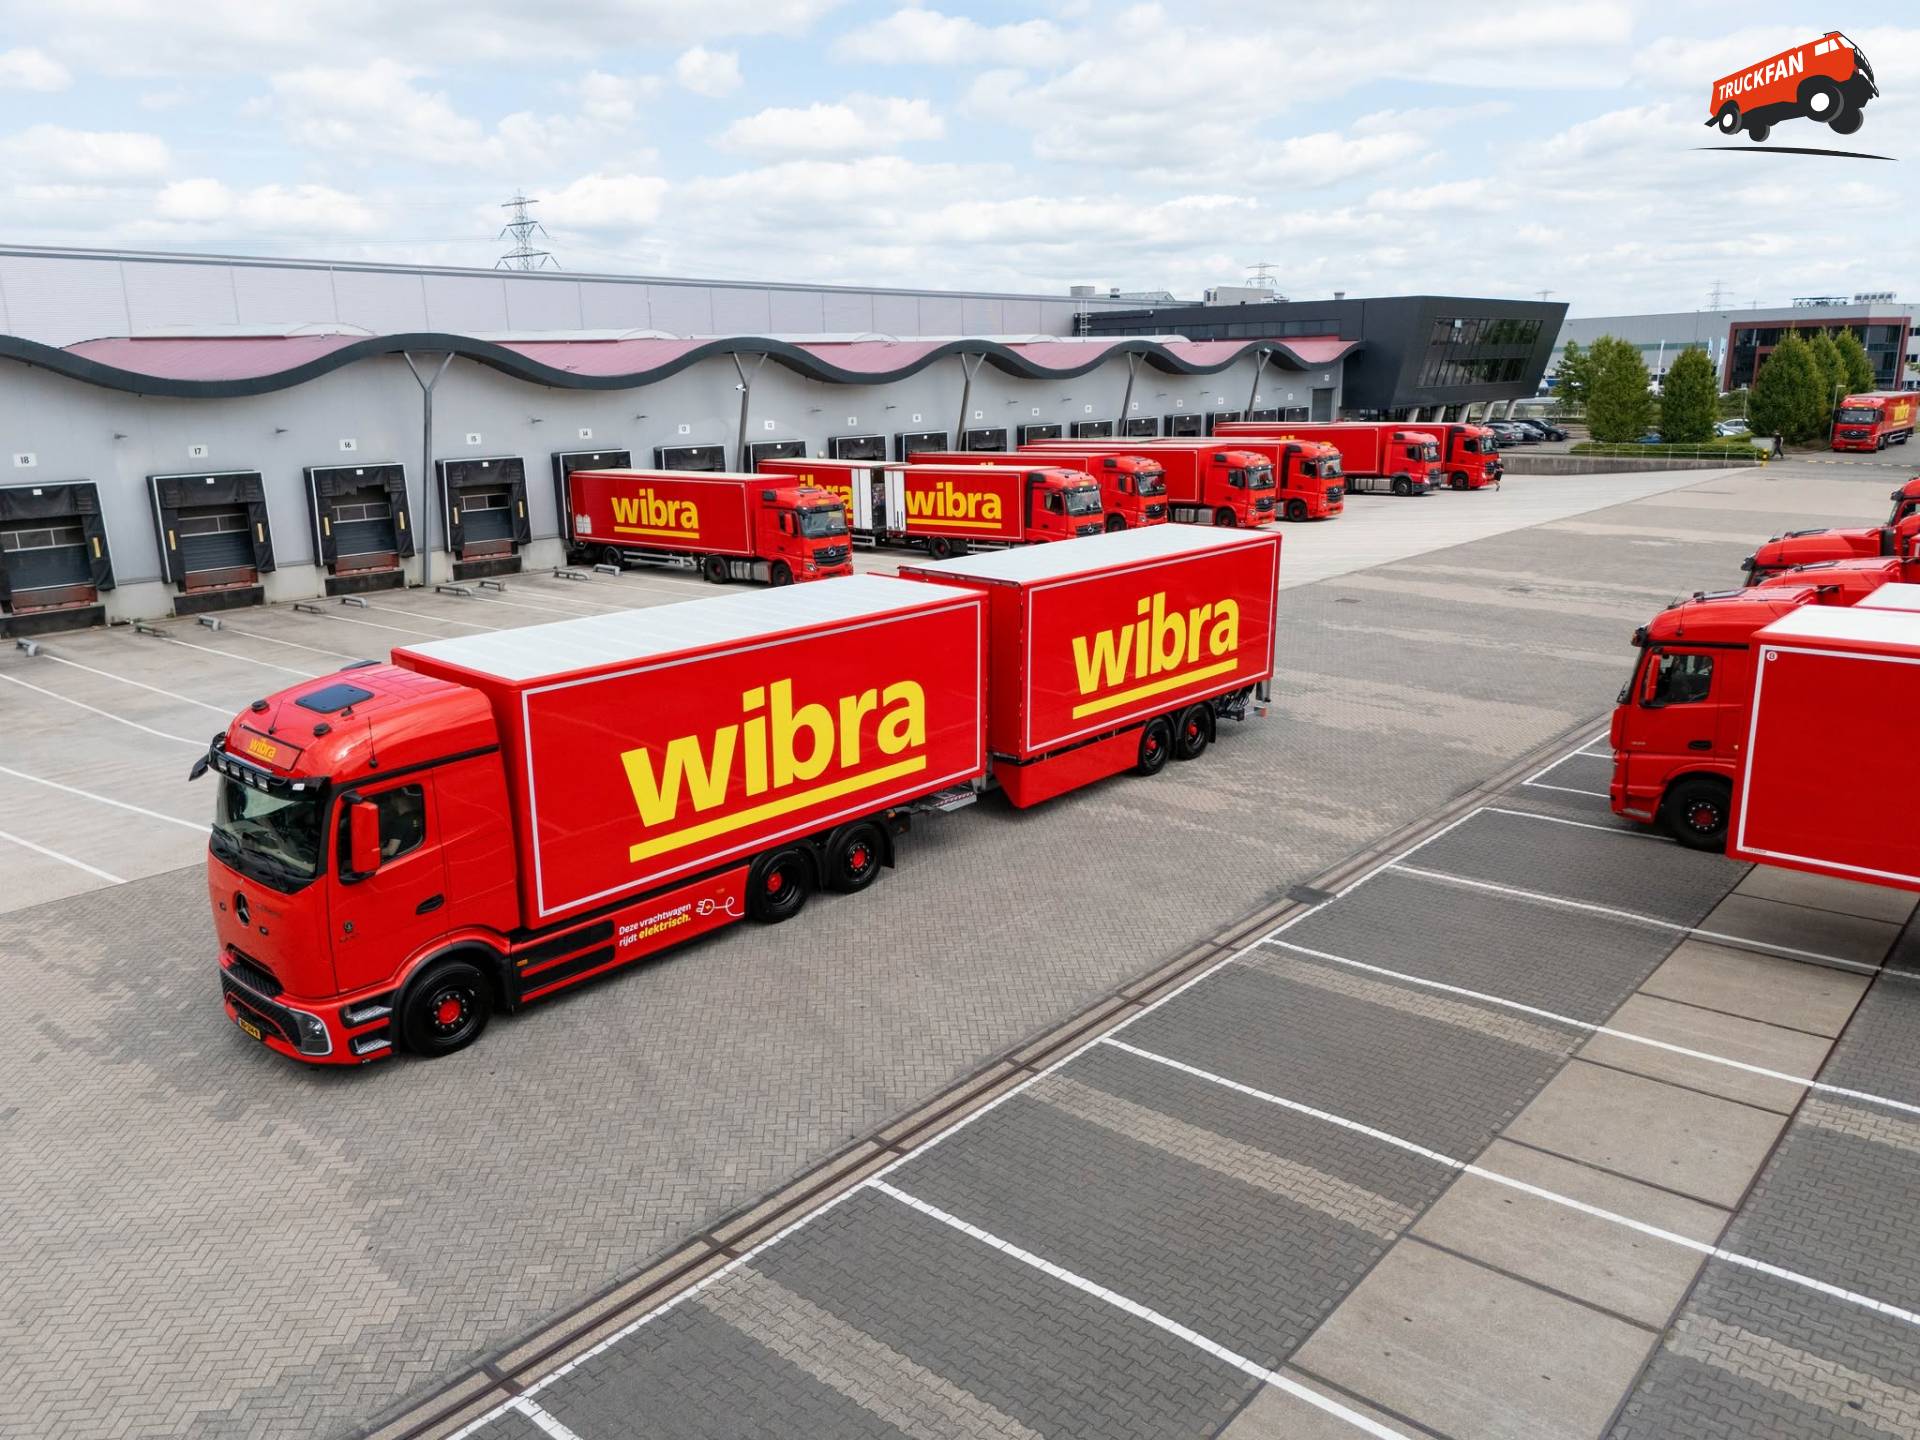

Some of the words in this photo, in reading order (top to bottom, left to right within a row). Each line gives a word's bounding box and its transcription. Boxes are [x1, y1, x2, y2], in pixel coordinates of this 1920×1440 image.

[20, 456, 30, 465] 18
[194, 447, 202, 455] 17
[611, 488, 699, 529] wibra
[907, 482, 1002, 519] wibra
[1072, 592, 1239, 695] wibra
[248, 736, 277, 759] wibra
[620, 678, 926, 828] wibra
[618, 922, 639, 935] Deze
[639, 903, 691, 927] vrachtwagen
[619, 933, 638, 947] rijdt
[638, 913, 692, 939] elektrisch.
